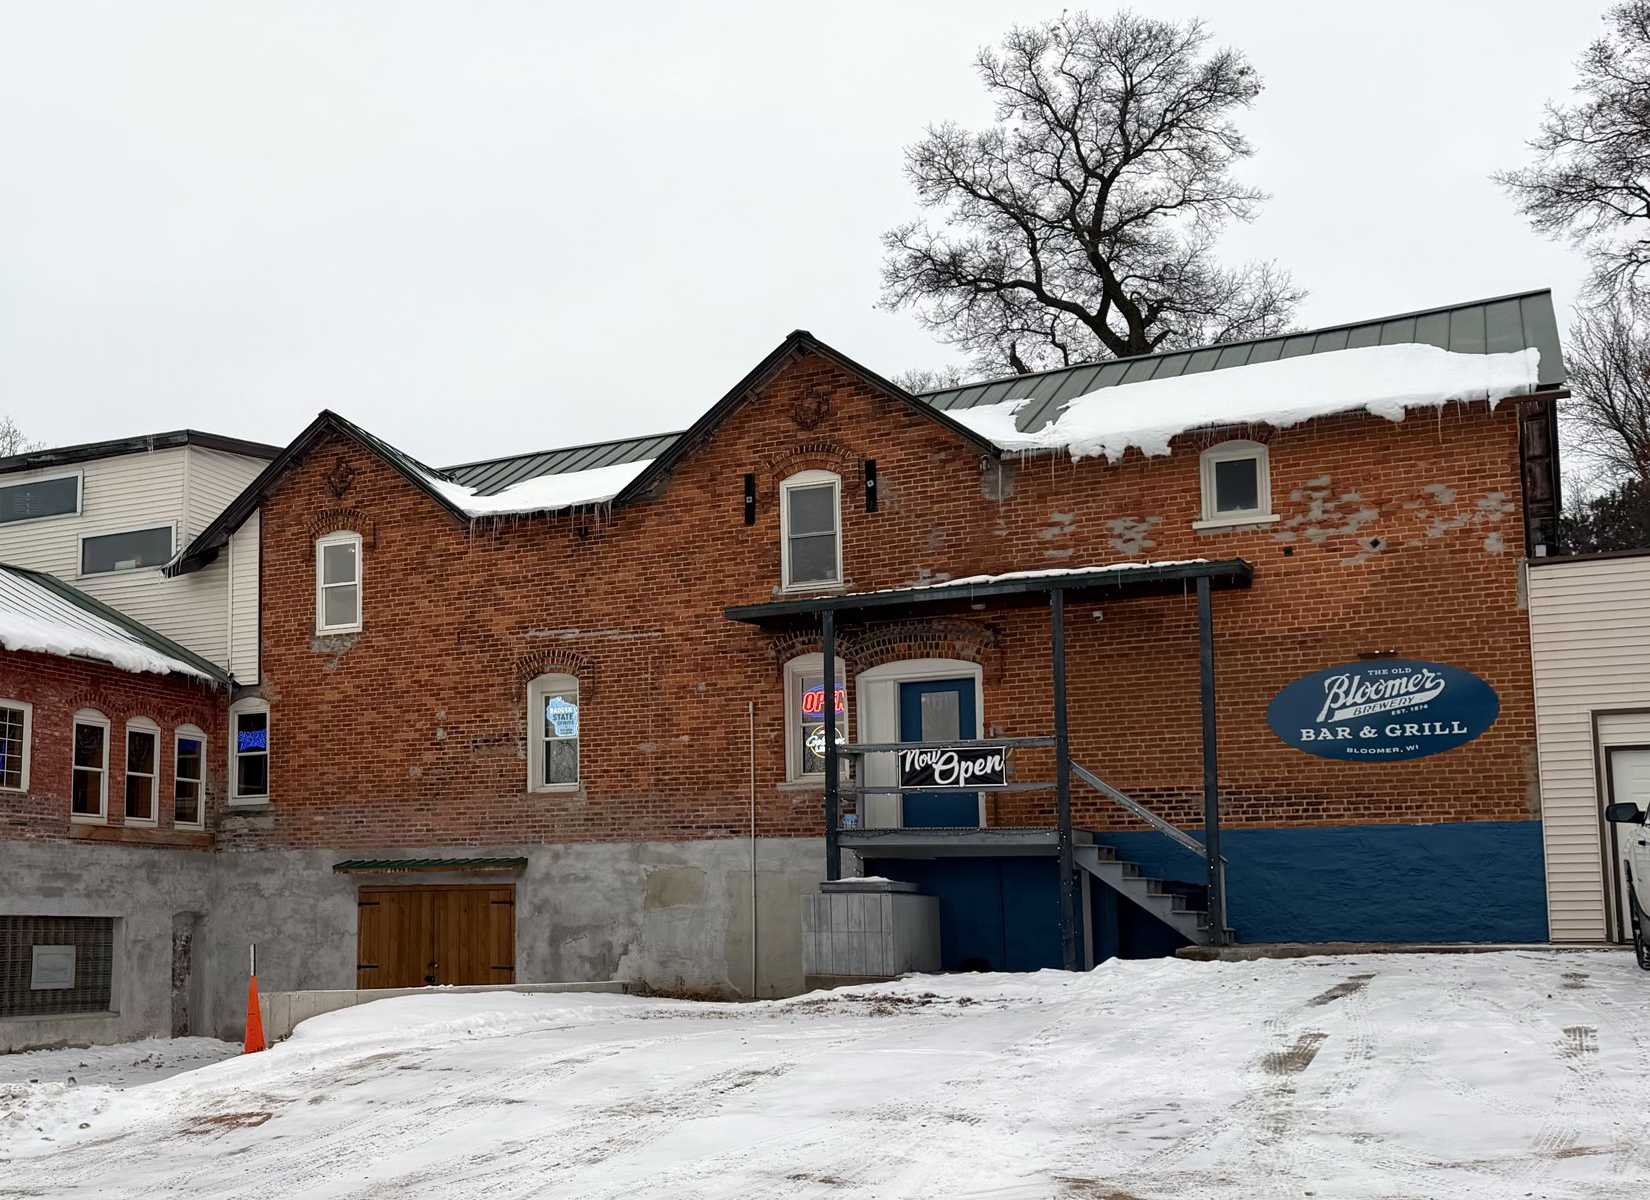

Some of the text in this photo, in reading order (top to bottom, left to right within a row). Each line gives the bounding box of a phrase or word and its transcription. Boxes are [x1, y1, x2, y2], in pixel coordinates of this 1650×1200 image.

[1315, 668, 1446, 723] Bloomer
[1352, 695, 1416, 717] BREWERY
[1300, 721, 1468, 742] BAR & GRILL
[898, 749, 1005, 788] Now Open
